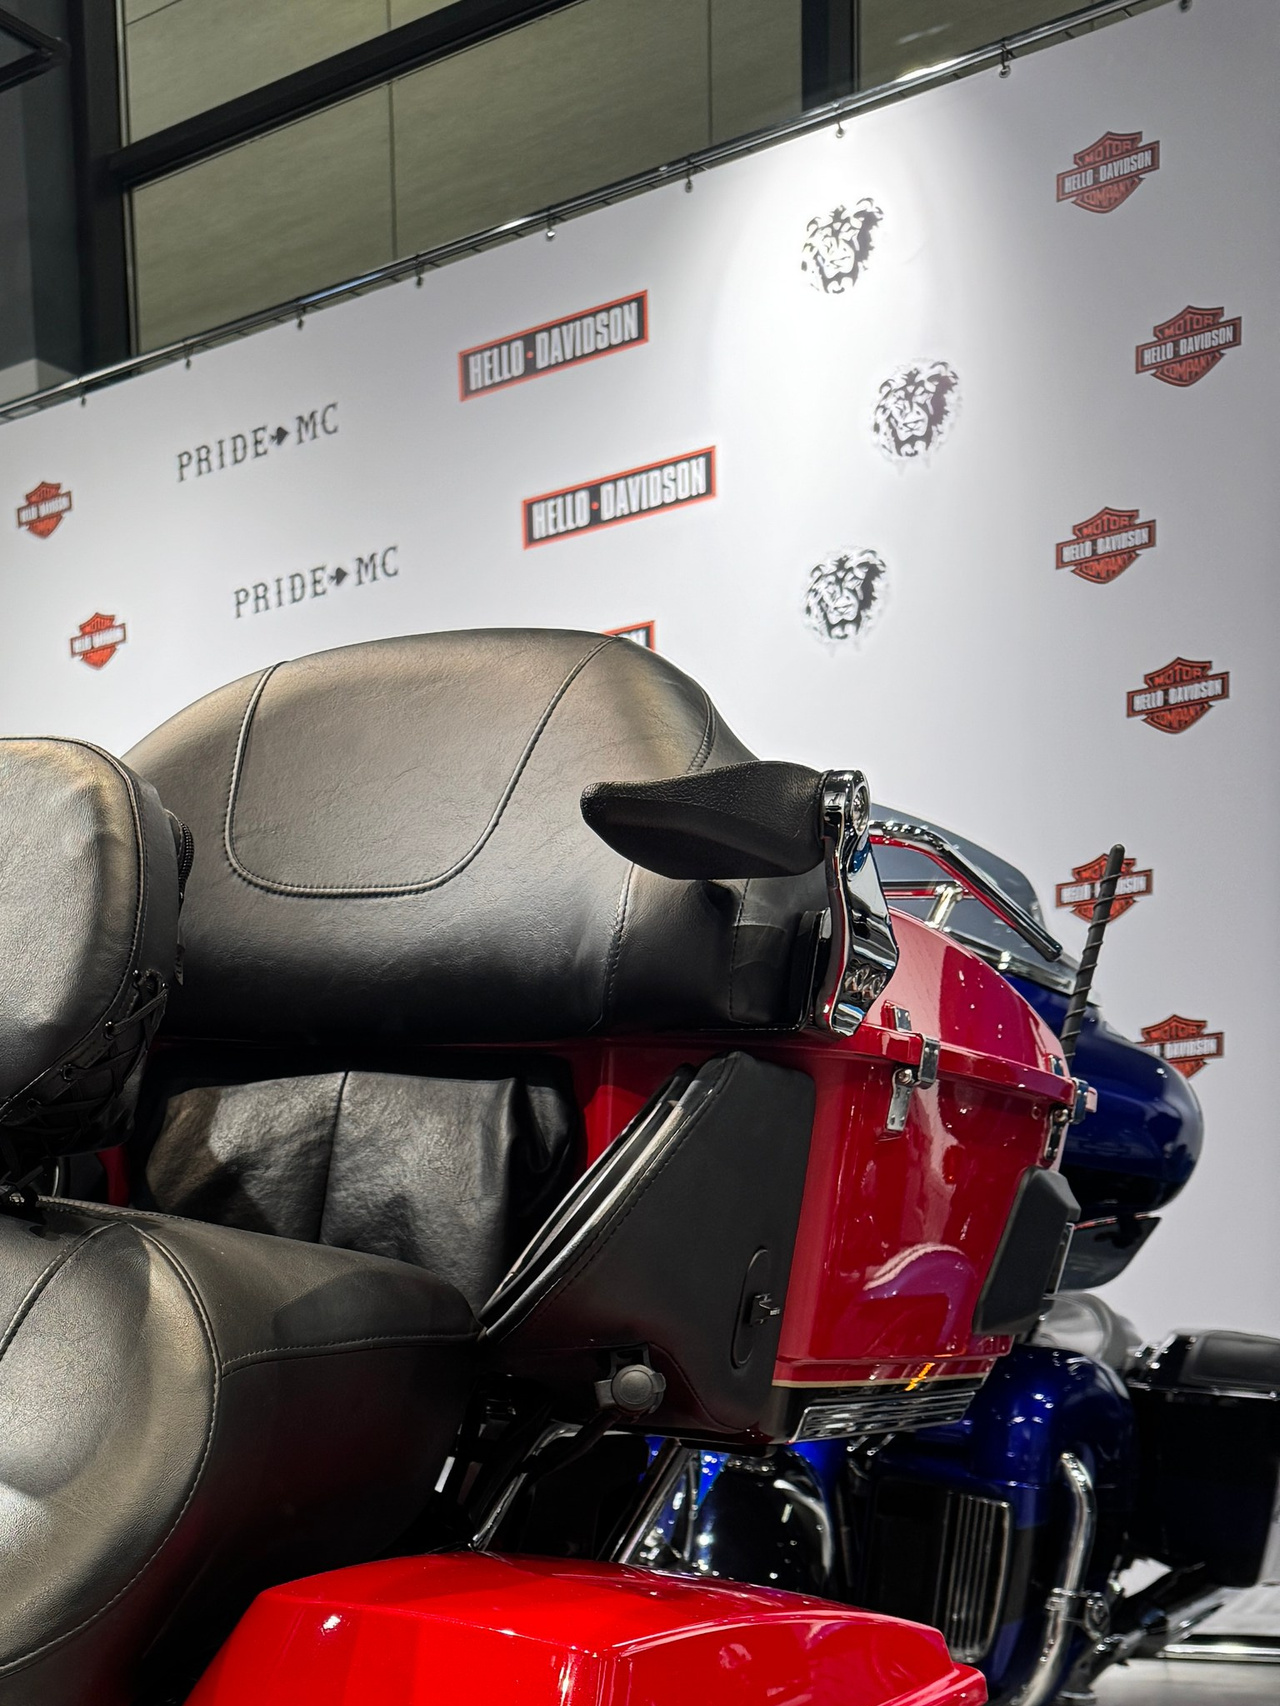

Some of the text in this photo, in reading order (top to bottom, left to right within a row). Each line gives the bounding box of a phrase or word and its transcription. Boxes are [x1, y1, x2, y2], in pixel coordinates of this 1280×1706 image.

[1084, 139, 1131, 164] MOTOR
[1064, 150, 1152, 193] HELLO DAVIDSON
[1163, 315, 1214, 337] MOTOR
[468, 302, 639, 391] HELLO DAVIDSON
[1143, 325, 1234, 366] HELLO DAVIDSON
[1163, 353, 1213, 381] COMPANY
[177, 402, 339, 483] PRIDE MC
[531, 457, 707, 540] HELLO DAVIDSON
[1082, 514, 1130, 536] MOTOR
[1062, 527, 1150, 563] HELLO DAVIDSON
[234, 546, 400, 619] PRIDE MC
[1153, 664, 1203, 686] MOTOR
